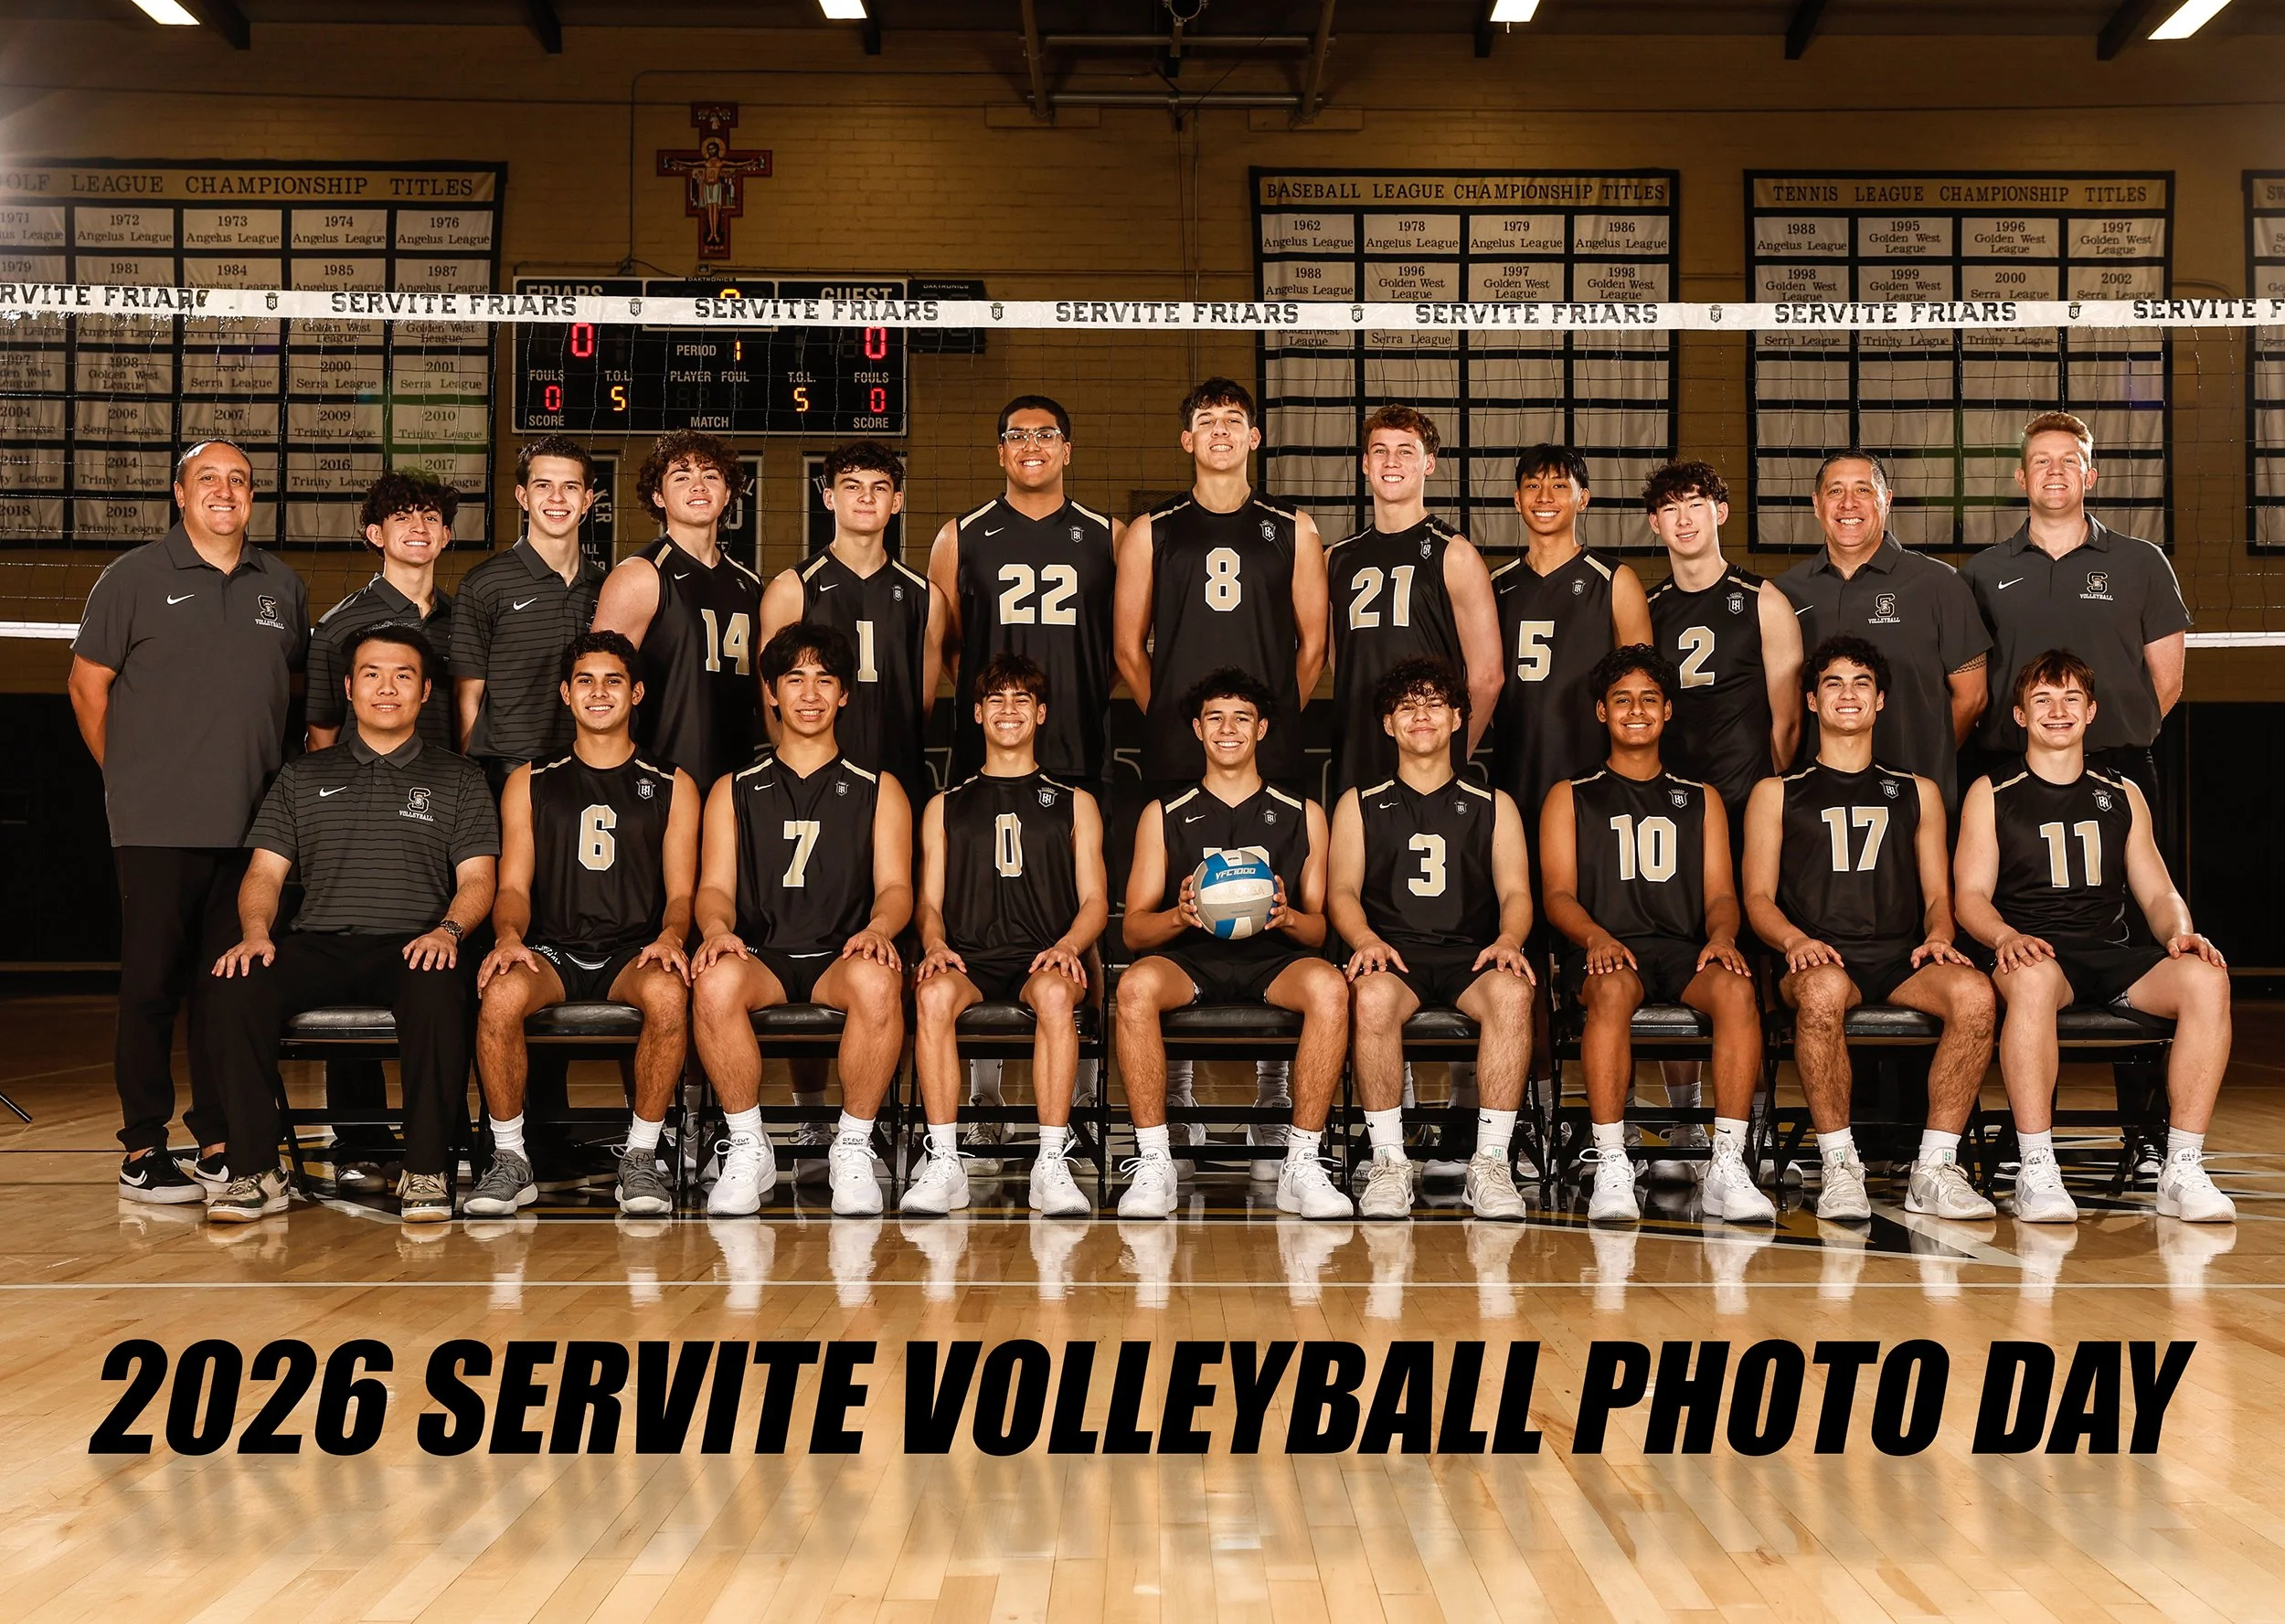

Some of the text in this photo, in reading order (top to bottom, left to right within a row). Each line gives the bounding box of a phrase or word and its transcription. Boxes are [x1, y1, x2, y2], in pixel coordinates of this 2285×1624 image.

[5, 174, 473, 196] OLF LEAGUE CHAMPIONSHIP TITLES
[1267, 184, 1664, 200] BASEBALL LEAGUE CHAMPIONSHIP TITLES
[1773, 186, 2147, 202] TENNIS LEAGUE CHAMPIONSHIP TITLES
[110, 215, 140, 226] 1972
[218, 216, 248, 227] 1973
[324, 217, 354, 228] 1974
[430, 218, 459, 228] 1976
[1293, 220, 1321, 231] 1962
[1398, 221, 1426, 231] 1978
[1504, 221, 1530, 231] 1979
[1609, 221, 1635, 232] 1986
[1787, 224, 1816, 235] 1988
[1891, 221, 1920, 232] 1995
[1995, 221, 2025, 232] 1996
[2102, 222, 2132, 233] 1997
[77, 231, 173, 244] Angelus League
[186, 232, 279, 244] Angelus League
[292, 233, 386, 245] Angelus League
[398, 234, 490, 246] Angelus League
[1264, 237, 1354, 249] Angelus League
[1869, 233, 1941, 243] Golden West
[1974, 234, 2046, 244] Golden West
[2080, 235, 2152, 245] Golden West
[1366, 239, 1459, 249] Angelus League
[1471, 239, 1563, 249] Angelus League
[1576, 239, 1667, 249] Angelus League
[1757, 240, 1847, 252] Angelus League
[1886, 245, 1926, 254] League
[1990, 245, 2030, 255] League
[2096, 246, 2136, 256] League
[2, 261, 32, 272] 1979
[110, 263, 140, 274] 1981
[217, 265, 248, 276] 1984
[324, 265, 355, 275] 1985
[428, 265, 457, 277] 1987
[1398, 266, 1425, 276] 1996
[1503, 266, 1530, 277] 1997
[1296, 268, 1322, 279] 1988
[1609, 267, 1635, 278] 1998
[1787, 269, 1816, 280] 1998
[1891, 269, 1920, 280] 1999
[1994, 272, 2026, 283] 2000
[1378, 279, 1445, 288] Golden West
[1483, 279, 1550, 289] Golden West
[1587, 279, 1655, 289] Golden West
[2101, 273, 2132, 284] 2002
[1266, 285, 1354, 296] Angelus League
[1766, 281, 1837, 292] Golden West
[1869, 281, 1941, 292] Golden West
[1392, 291, 1432, 300] League
[1495, 291, 1537, 300] League
[1600, 291, 1642, 300] League
[1782, 292, 1823, 303] League
[1886, 292, 1926, 302] League
[1971, 289, 2049, 300] Serra League
[2077, 290, 2156, 300] Serra League
[331, 292, 577, 316] SERVITE FRIARS
[695, 298, 939, 321] SERVITE FRIARS
[2133, 299, 2257, 319] SERVITE
[1056, 302, 1299, 324] SERVITE FRIARS
[1416, 303, 1658, 324] SERVITE FRIARS
[1775, 302, 2016, 324] SERVITE FRIARS
[571, 323, 593, 357] 0
[864, 327, 887, 359] 0
[1289, 336, 1328, 346] League
[1372, 333, 1451, 345] Serra League
[676, 345, 717, 356] PERIOD
[529, 369, 565, 382] FOULS
[670, 371, 749, 383] PLAYER FOUL
[788, 372, 816, 383] T.O.L.
[854, 372, 889, 384] FOULS
[296, 378, 377, 390] Serra League
[545, 385, 561, 411] 0
[611, 386, 626, 411] 5
[793, 387, 809, 412] 5
[870, 387, 886, 413] 0
[425, 410, 455, 421] 2010
[528, 415, 565, 427] SCORE
[690, 416, 729, 428] MATCH
[853, 417, 889, 429] SCORE
[320, 459, 351, 470] 2016
[1205, 547, 1242, 612] 8
[997, 563, 1078, 626] 22
[1348, 564, 1416, 631] 21
[701, 608, 750, 675] 14
[856, 620, 878, 683] 1
[1517, 620, 1556, 682] 5
[1677, 625, 1716, 689] 2
[408, 787, 431, 814] S
[399, 810, 434, 823] VOLLEYBALL
[578, 803, 618, 871] 6
[1821, 805, 1889, 873] 17
[994, 812, 1023, 877] 0
[1610, 813, 1678, 883] 10
[782, 820, 821, 887] 7
[2039, 819, 2102, 888] 11
[1408, 833, 1447, 897] 3
